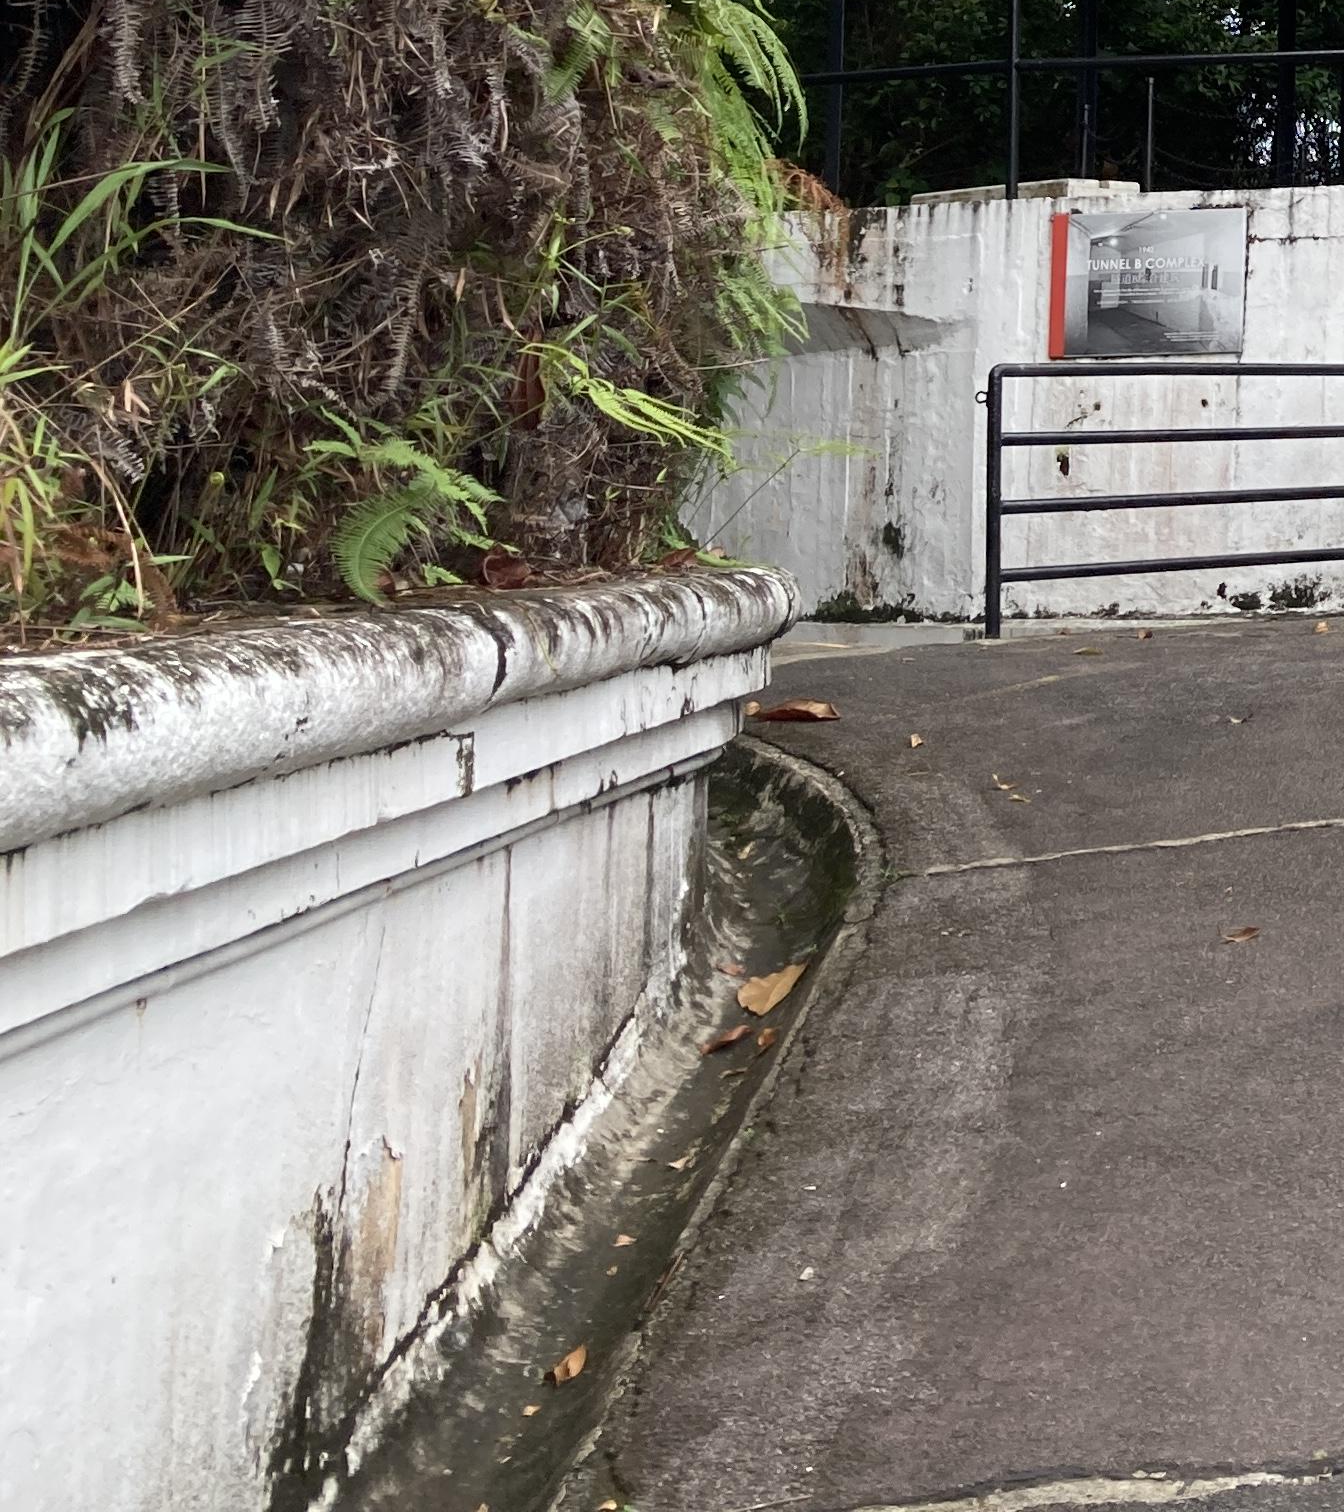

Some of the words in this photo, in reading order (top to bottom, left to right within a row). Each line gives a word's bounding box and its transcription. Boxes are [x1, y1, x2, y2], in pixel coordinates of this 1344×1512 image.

[1087, 258, 1132, 271] TUNNEL
[1134, 257, 1142, 269] B
[1145, 255, 1206, 269] COMPLEX
